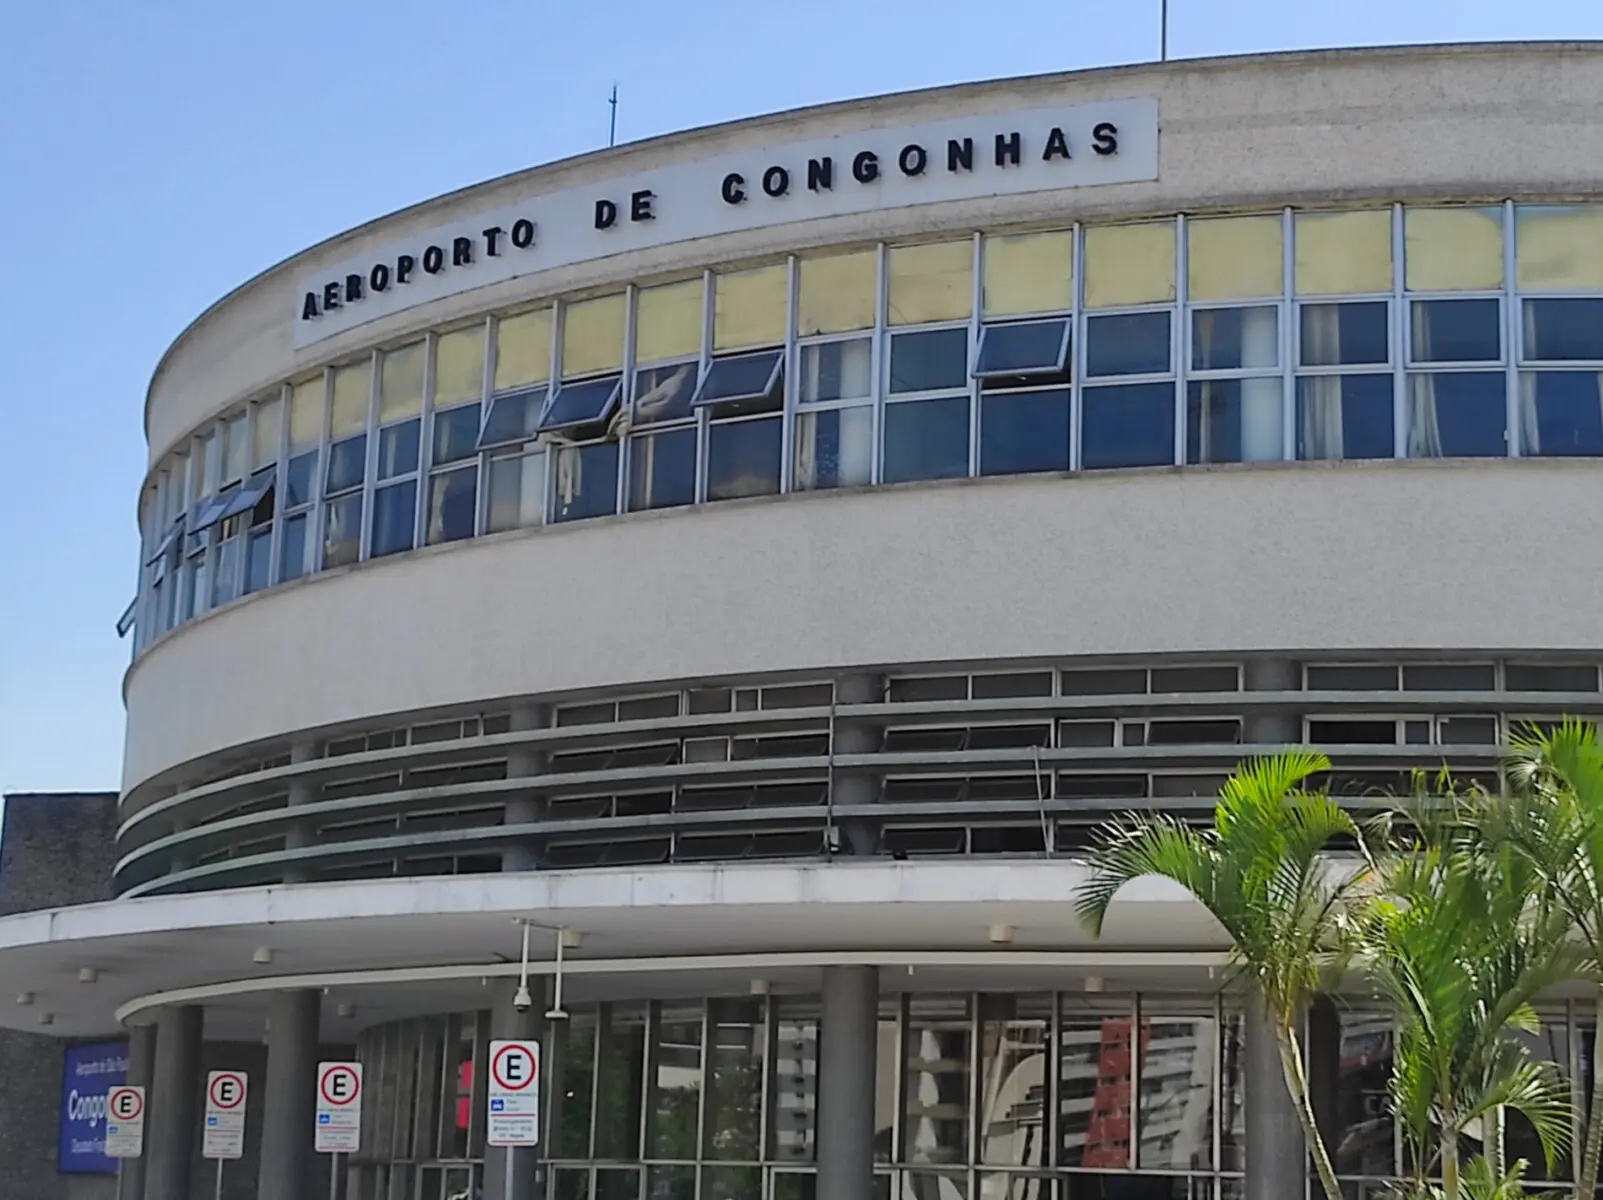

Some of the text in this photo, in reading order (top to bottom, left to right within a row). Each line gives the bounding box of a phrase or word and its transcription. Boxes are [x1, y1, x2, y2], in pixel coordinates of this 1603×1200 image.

[302, 122, 1119, 321] AEROPORTO DE CONGONHAS
[506, 1054, 522, 1080] E
[221, 1081, 234, 1101] E
[333, 1074, 347, 1096] E
[68, 1088, 108, 1128] Congo
[120, 1095, 133, 1113] E
